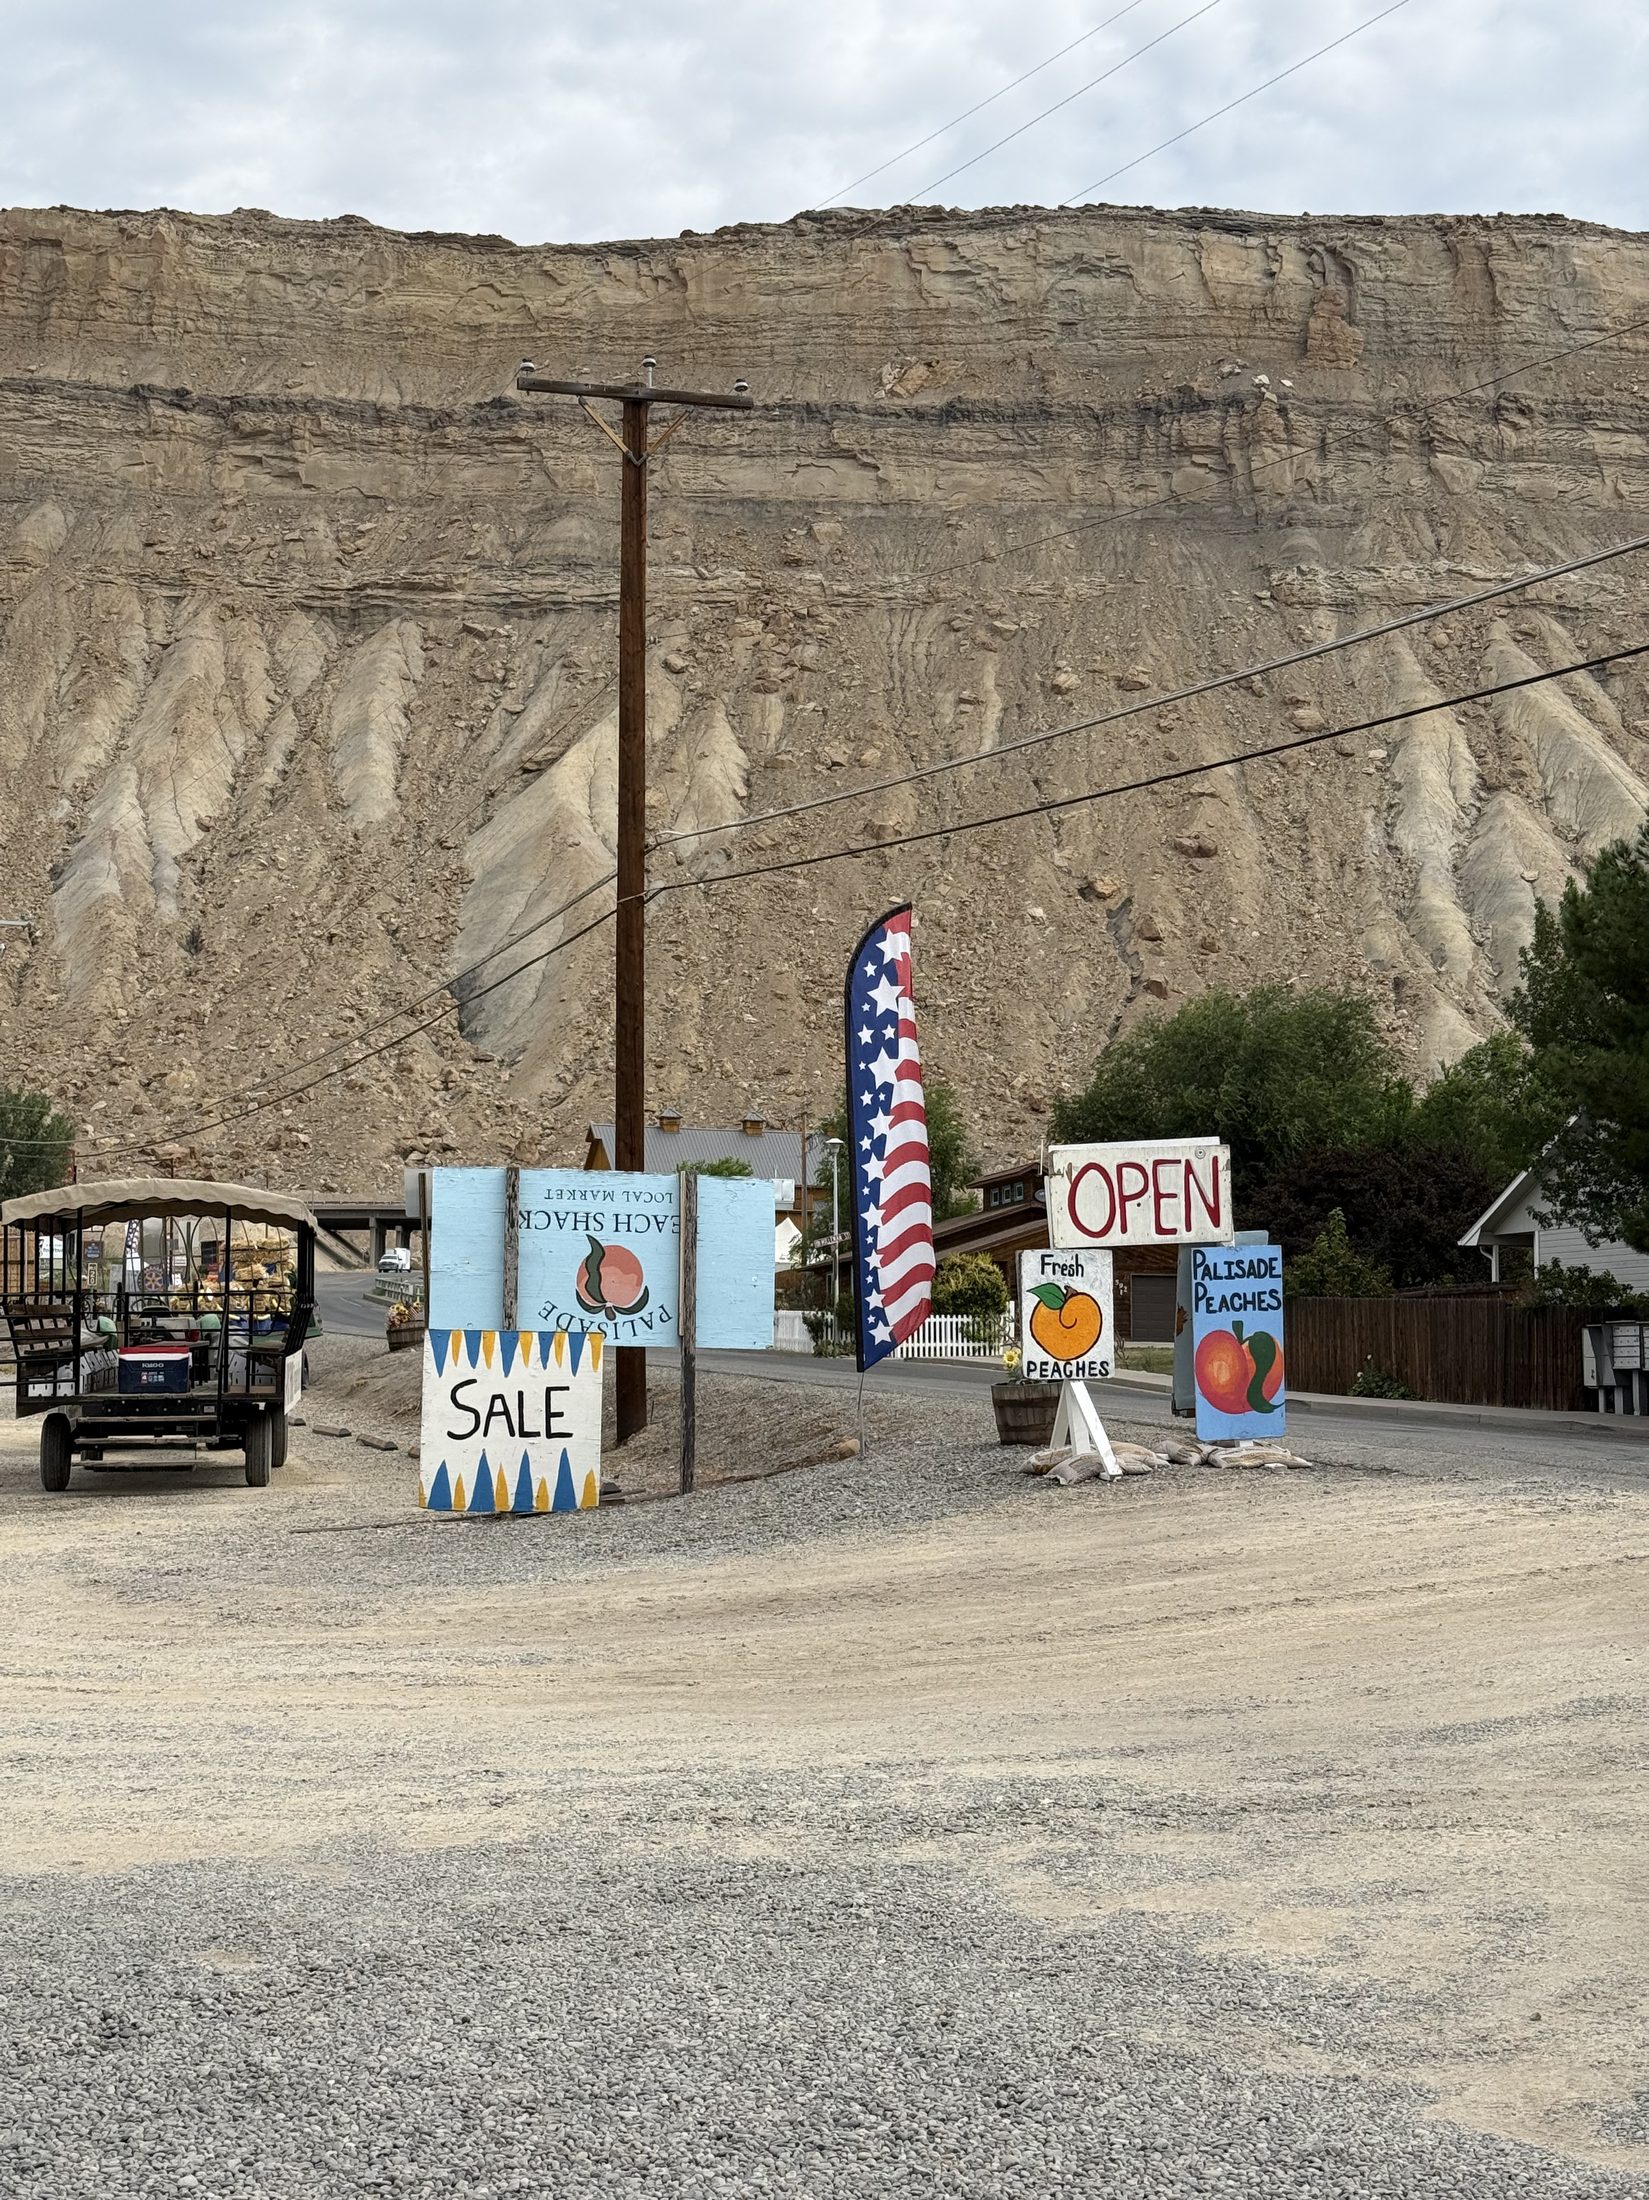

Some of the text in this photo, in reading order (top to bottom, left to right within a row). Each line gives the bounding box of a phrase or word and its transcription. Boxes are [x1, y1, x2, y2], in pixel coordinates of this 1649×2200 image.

[544, 1188, 673, 1204] LOCAL MARKET
[1067, 1155, 1221, 1239] OPEN
[519, 1210, 700, 1234] EACH SHACK
[1040, 1253, 1085, 1278] Fresh
[1192, 1249, 1282, 1281] PALISADE
[1194, 1281, 1282, 1314] PEACHES
[537, 1300, 673, 1340] PALISADE
[1026, 1360, 1110, 1379] PEACHES
[446, 1378, 574, 1440] SALE
